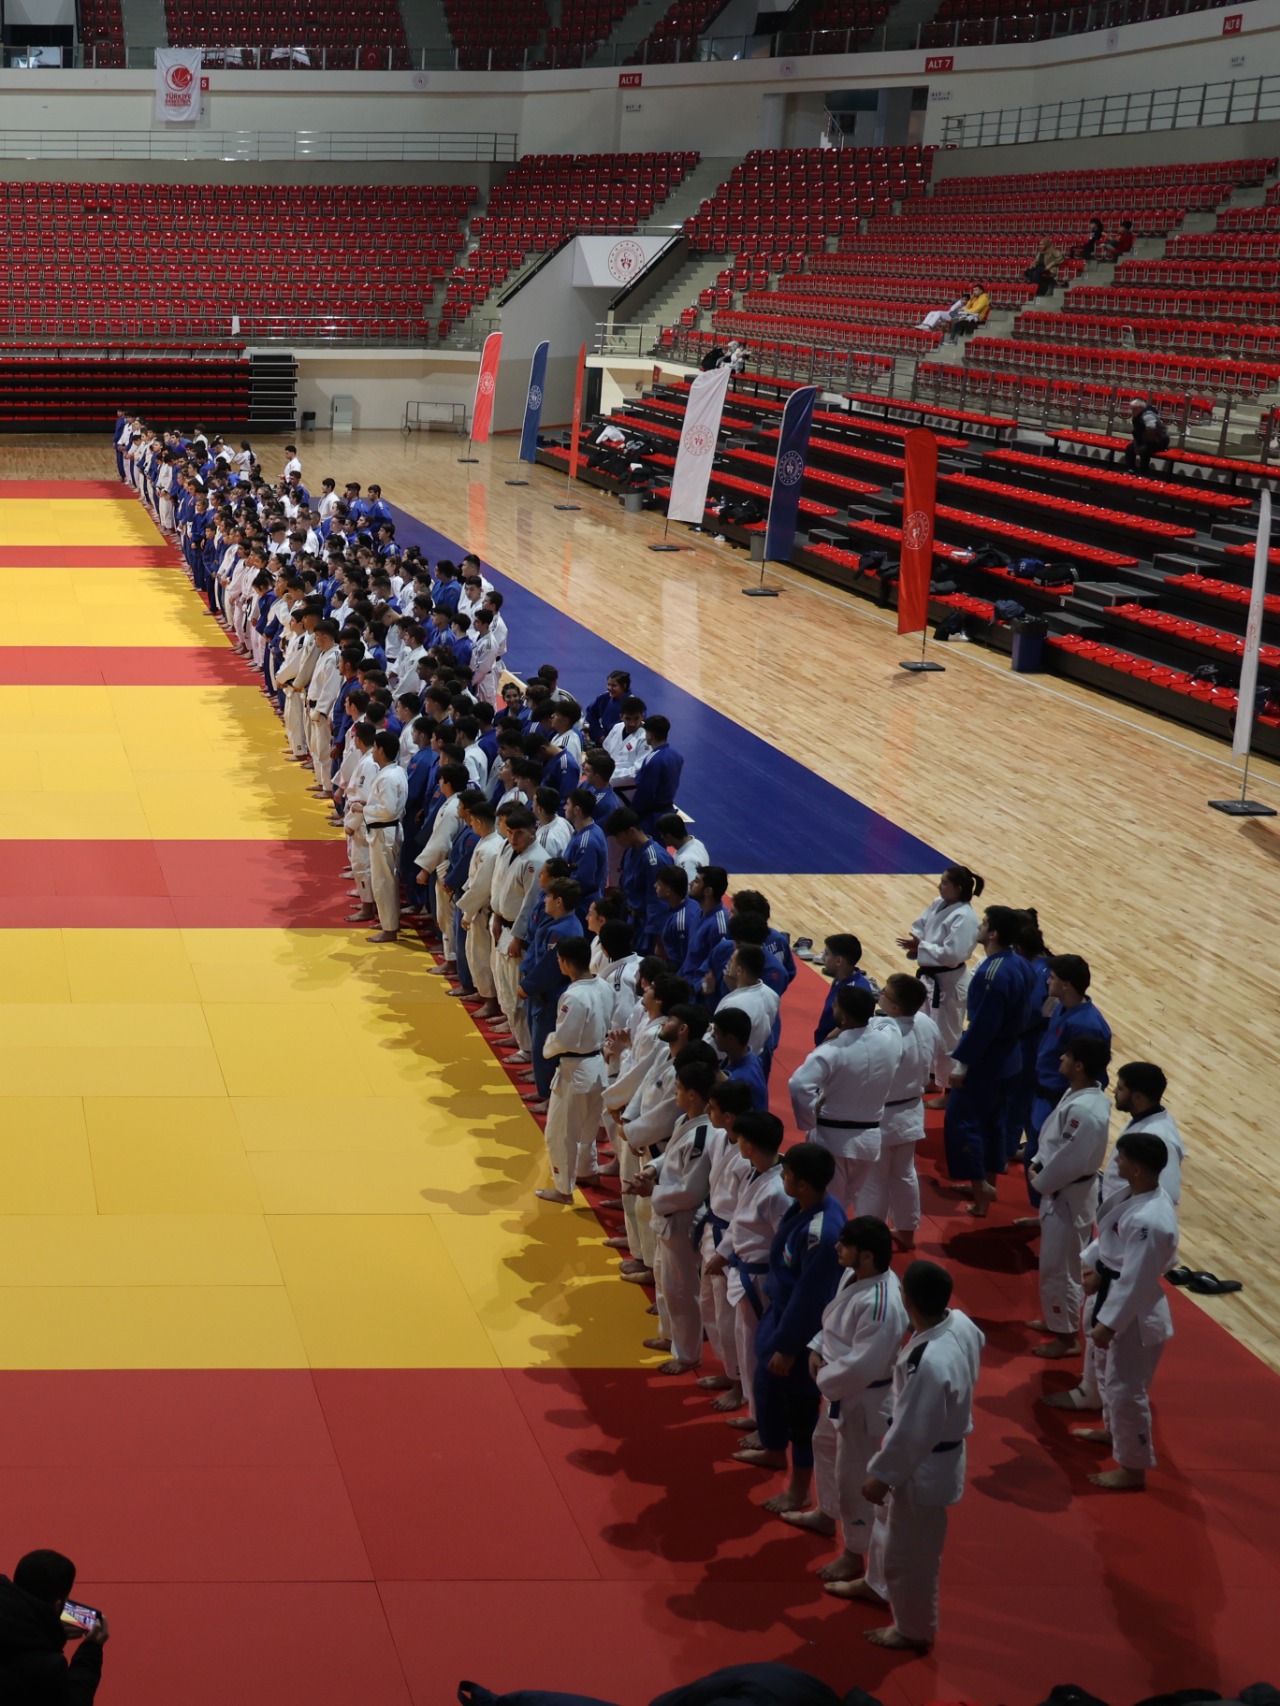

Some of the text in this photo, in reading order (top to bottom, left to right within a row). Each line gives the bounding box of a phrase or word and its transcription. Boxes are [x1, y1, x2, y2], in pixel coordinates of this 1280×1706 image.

[928, 59, 951, 69] ALT 7
[621, 76, 640, 85] ALT 6
